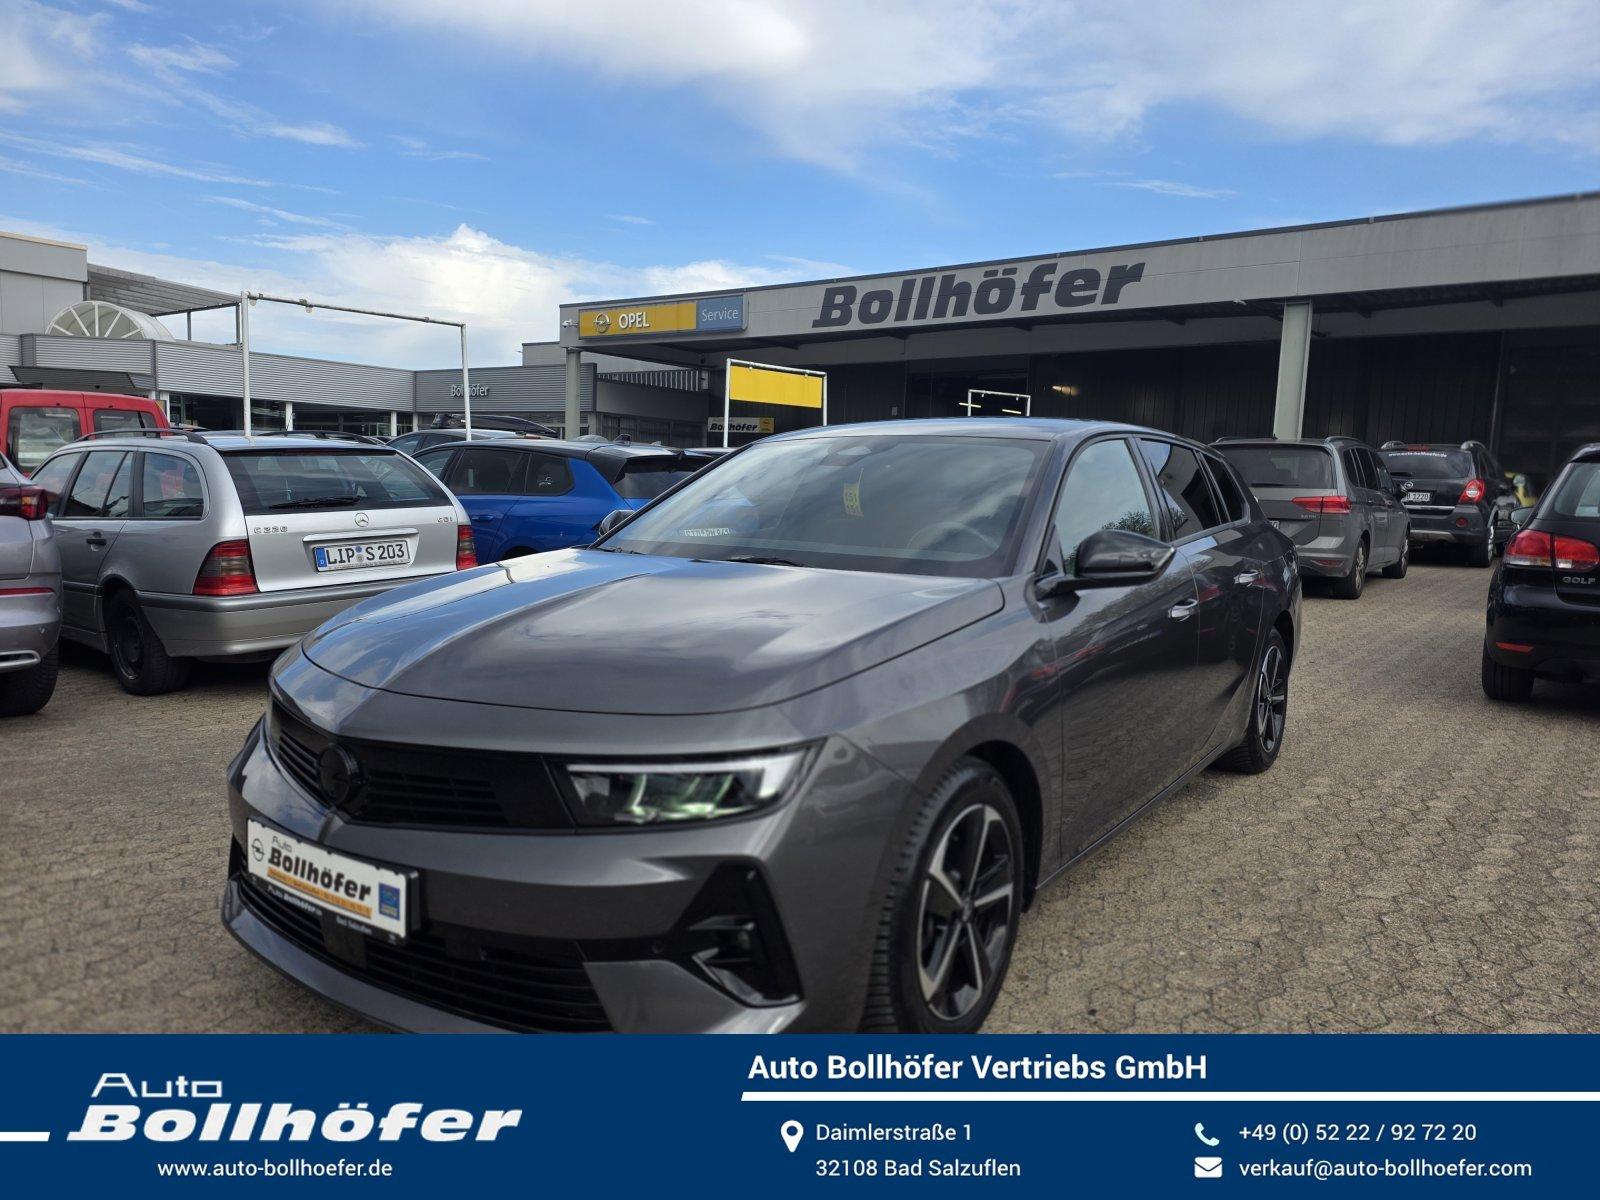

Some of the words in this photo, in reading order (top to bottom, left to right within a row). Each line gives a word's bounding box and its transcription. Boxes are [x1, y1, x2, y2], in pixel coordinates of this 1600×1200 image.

[811, 262, 1146, 328] Bollhöfer
[618, 311, 650, 329] OPEL
[701, 307, 739, 322] Service
[325, 548, 355, 565] LIP
[365, 546, 376, 561] S
[377, 544, 405, 560] 203
[1562, 576, 1596, 585] GOLF
[271, 835, 293, 853] Auto
[268, 847, 372, 901] Bollhöfer
